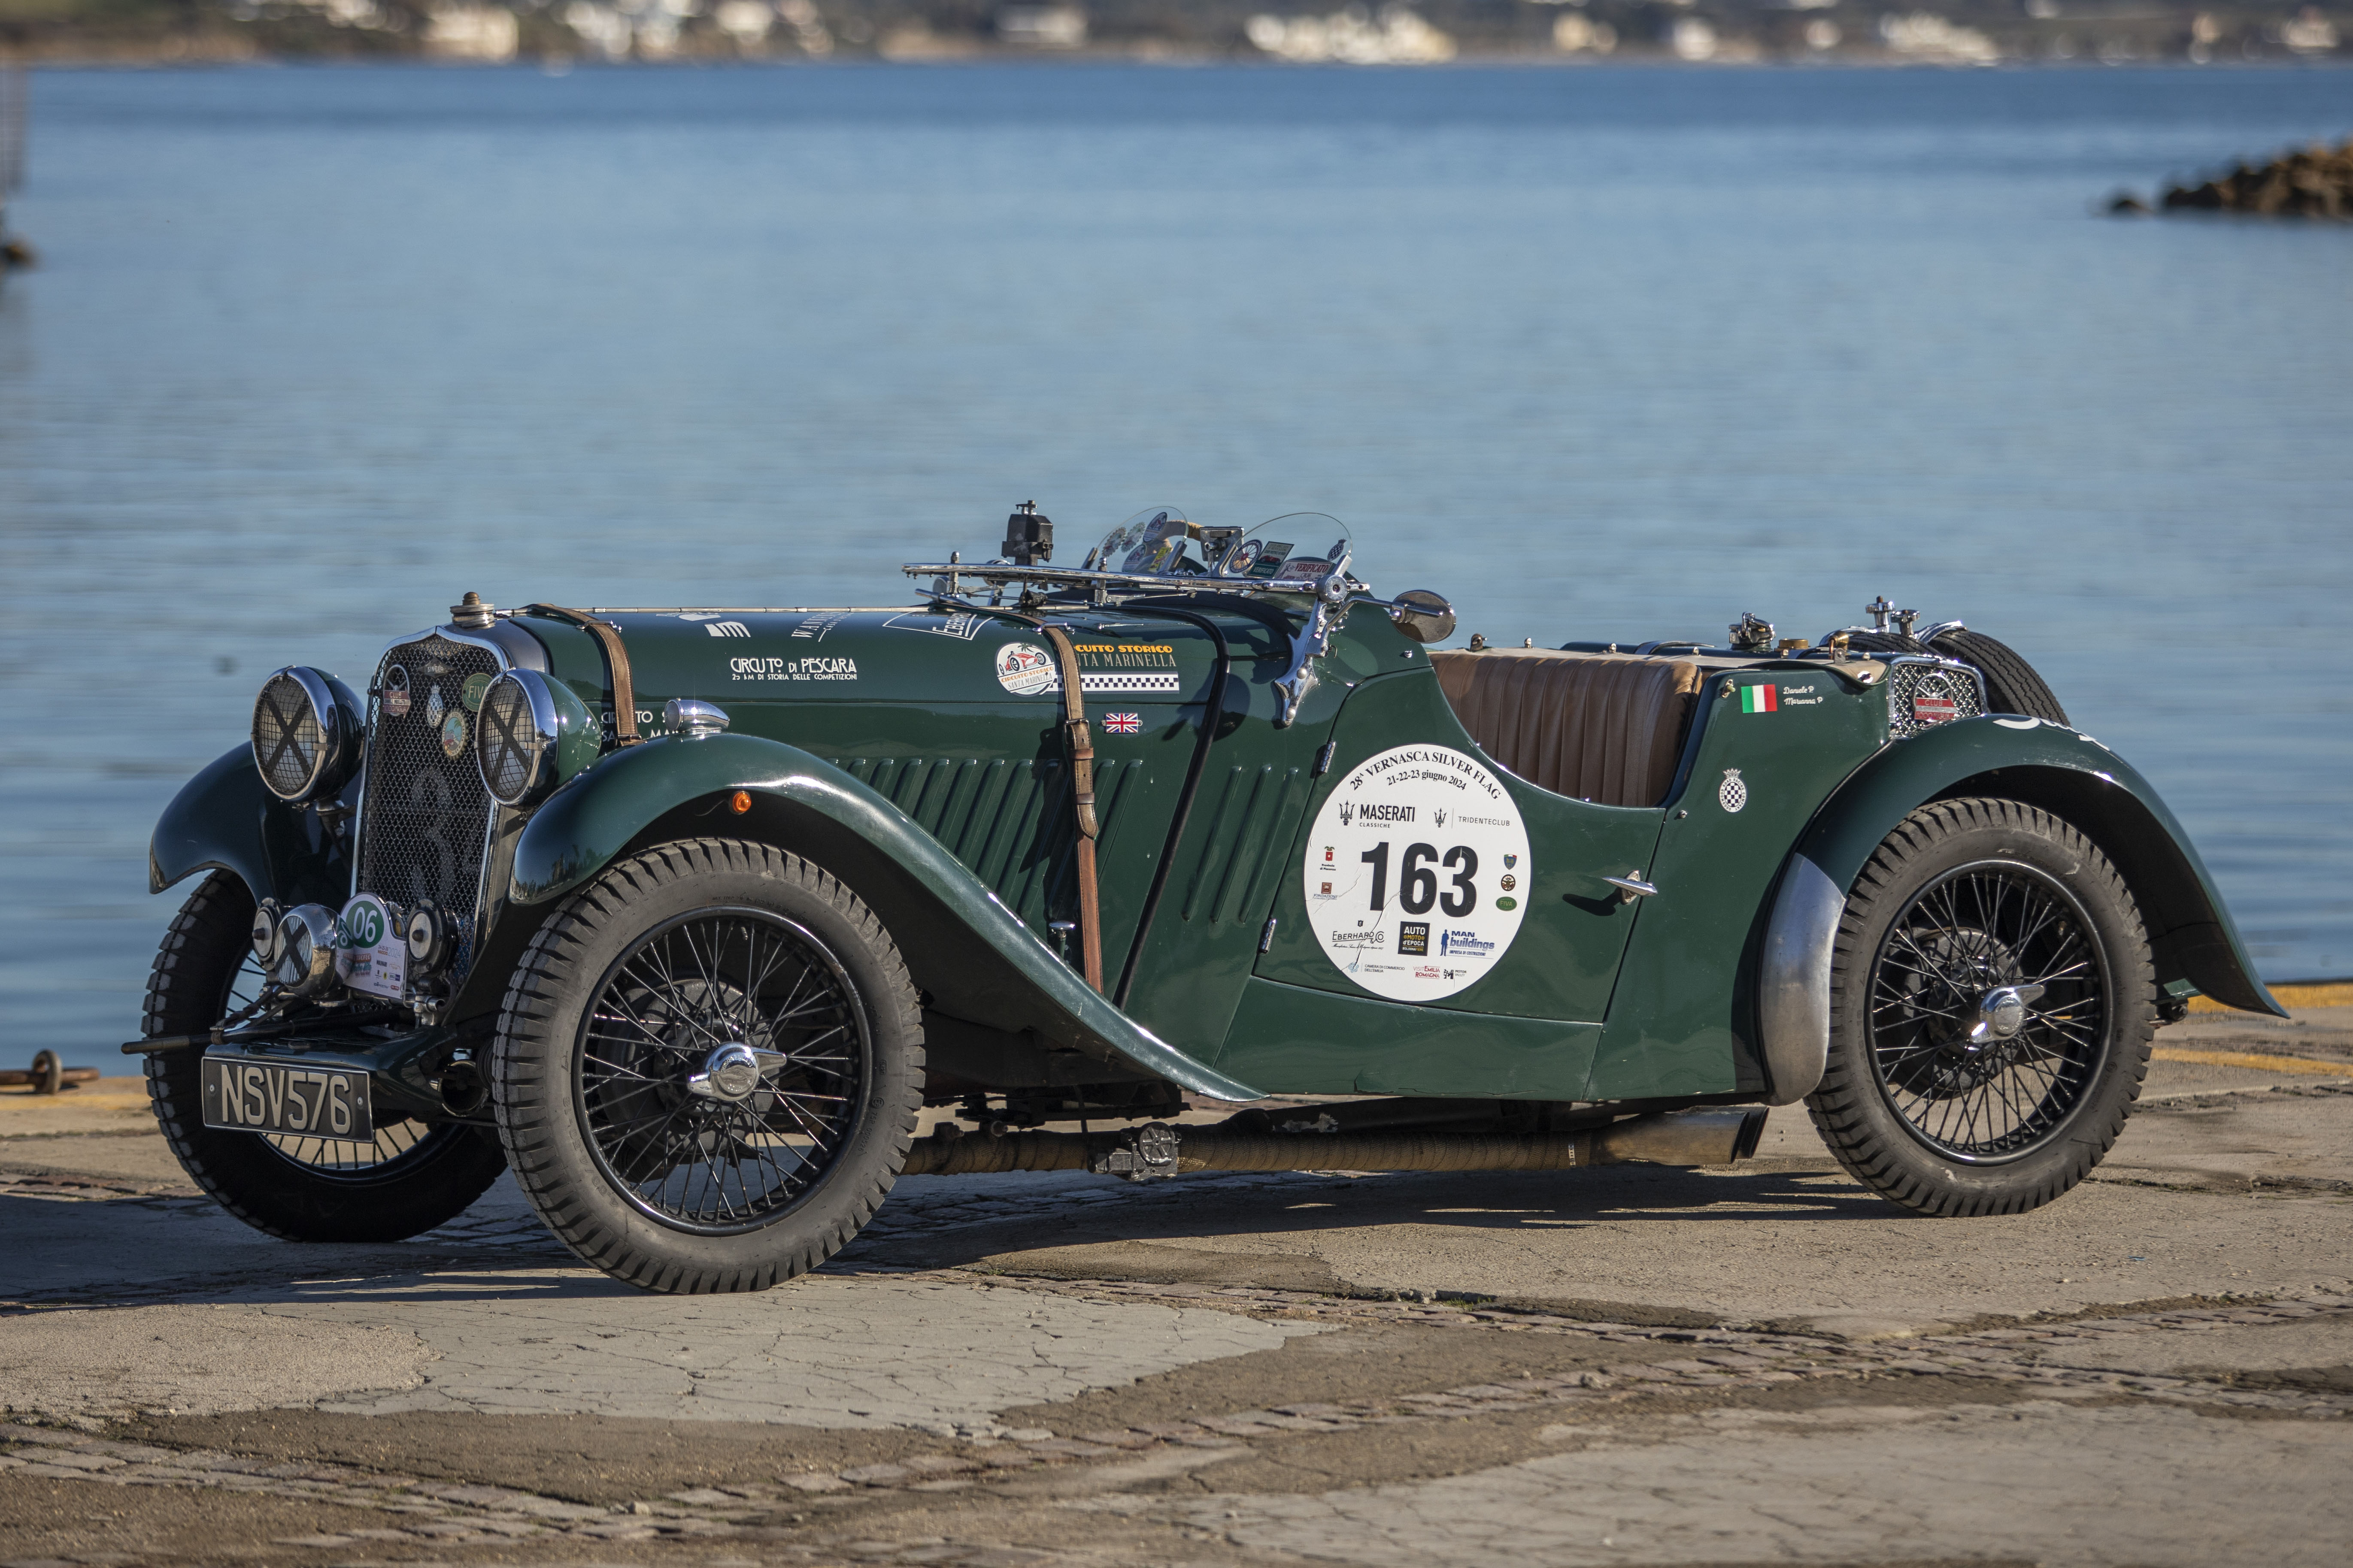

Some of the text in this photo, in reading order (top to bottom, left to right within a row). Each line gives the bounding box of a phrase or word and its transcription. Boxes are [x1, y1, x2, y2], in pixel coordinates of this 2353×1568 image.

[1295, 563, 1329, 573] VERIFICATO
[801, 658, 857, 673] PESCARA
[1103, 653, 1176, 667] MARINELLA
[1001, 666, 1054, 683] CIRCUITO STORICO
[1008, 672, 1052, 690] SANTA MARINELLA
[468, 685, 485, 699] FIV
[1365, 751, 1429, 777] VERNASCA
[1431, 752, 1473, 776] SILVER
[1473, 770, 1501, 800] FLAG
[1386, 769, 1468, 791] 21-22-23 giugno 2024
[1733, 778, 1745, 790] RACING
[1359, 804, 1416, 822] MASERATI
[1458, 816, 1511, 827] TRIDENTECLUB
[1361, 841, 1479, 918] 163
[353, 906, 378, 943] 06
[1404, 926, 1426, 935] AUTO
[1332, 930, 1375, 941] EBERHARD
[1450, 937, 1495, 951] buildings
[220, 1064, 352, 1135] NSV576
